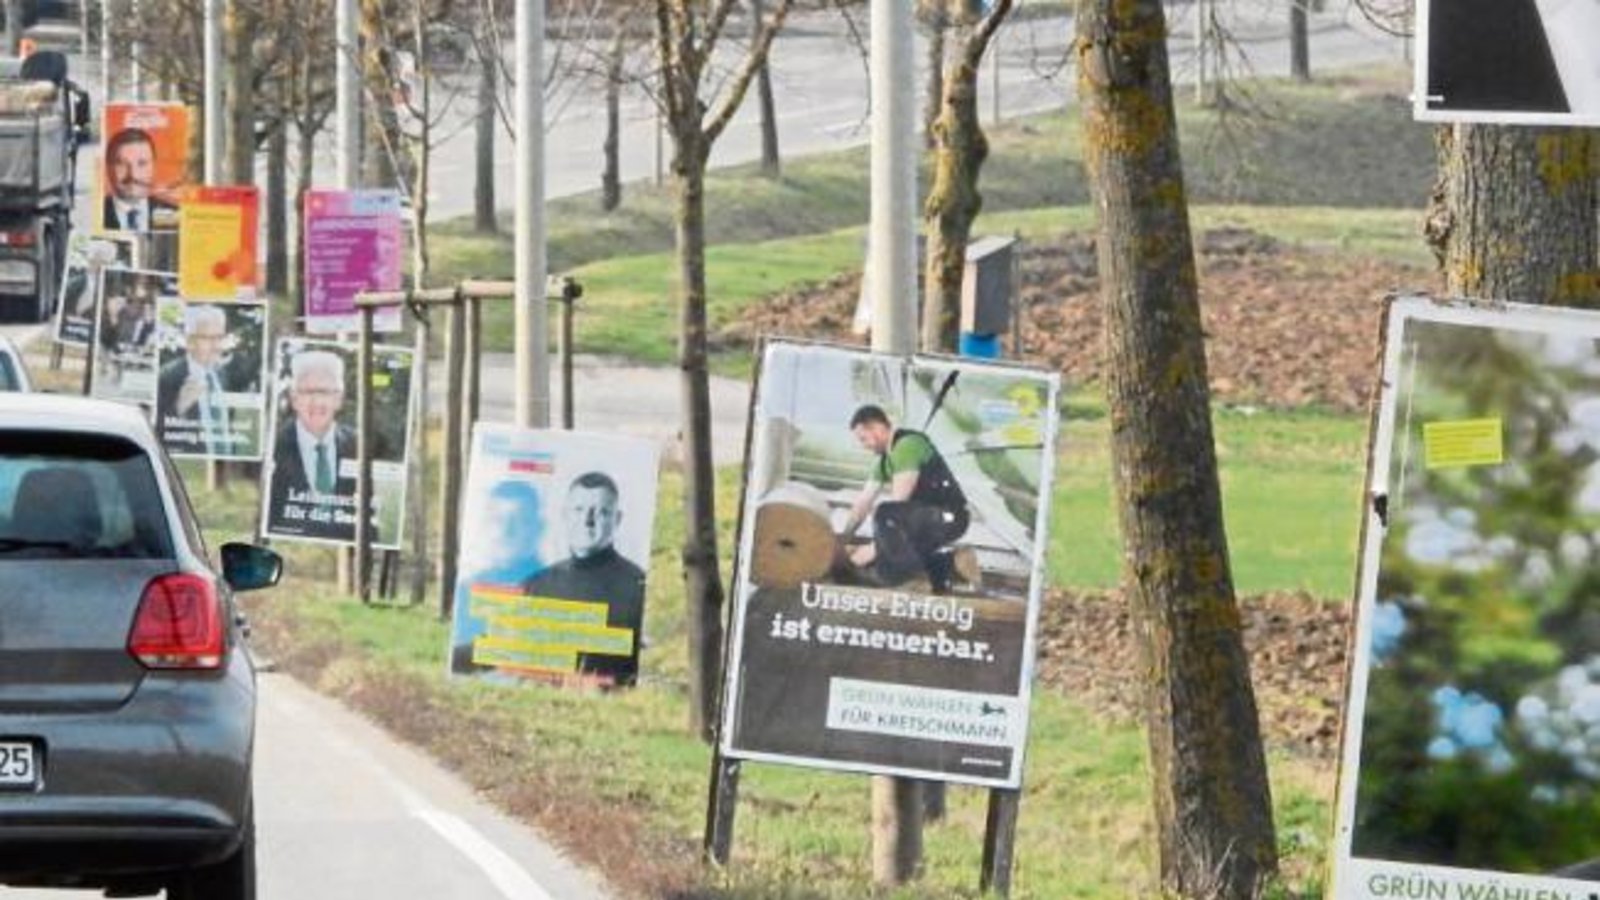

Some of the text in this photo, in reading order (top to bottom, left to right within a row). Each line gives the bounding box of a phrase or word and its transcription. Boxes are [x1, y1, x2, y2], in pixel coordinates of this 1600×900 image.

[801, 582, 974, 631] Unser Erfolg
[771, 613, 995, 662] ist erneuerbar.
[840, 706, 1006, 740] FÜR KRETSCHMANN
[1368, 871, 1447, 899] GRÜN
